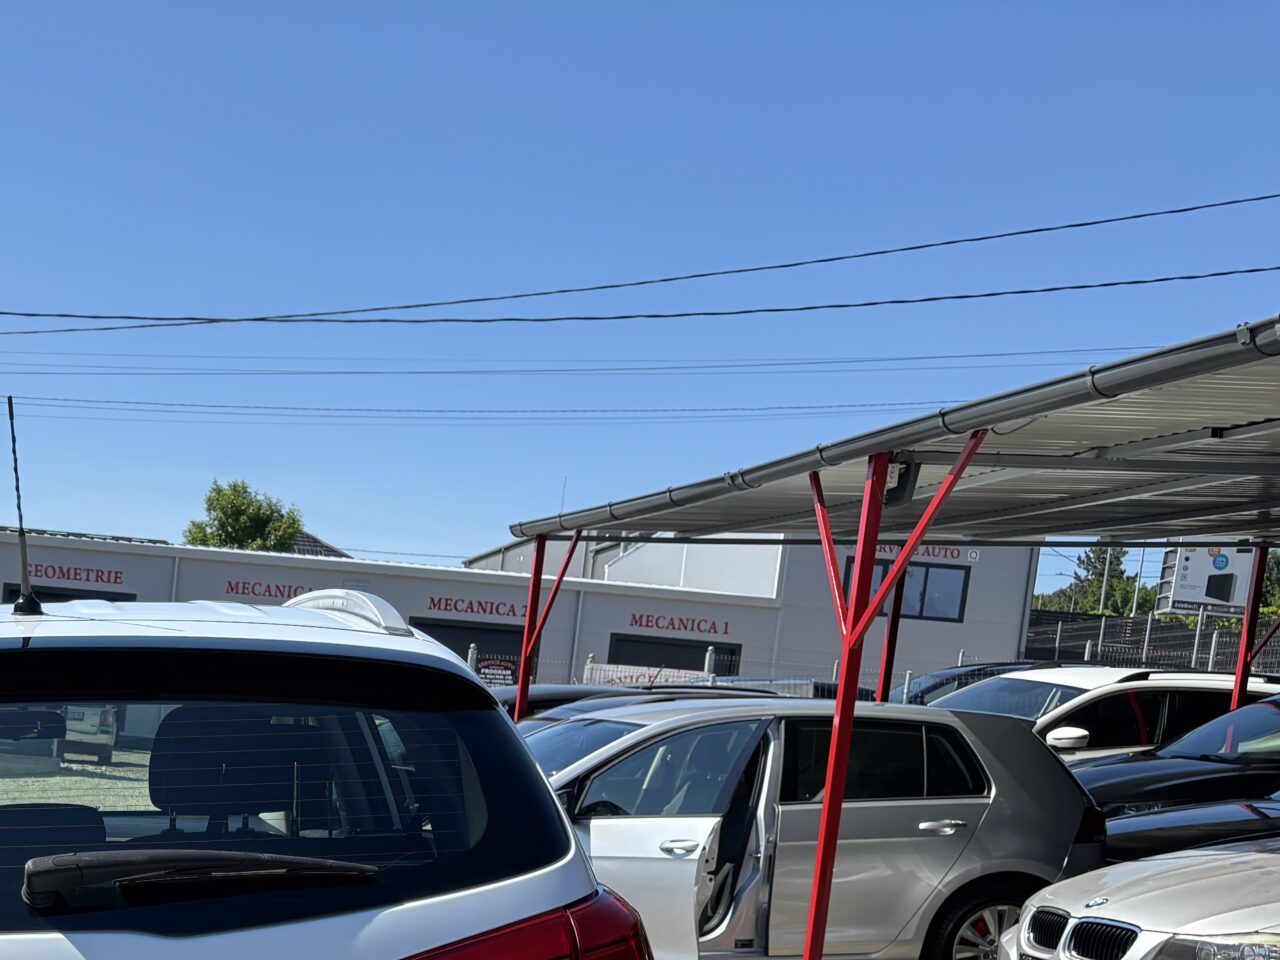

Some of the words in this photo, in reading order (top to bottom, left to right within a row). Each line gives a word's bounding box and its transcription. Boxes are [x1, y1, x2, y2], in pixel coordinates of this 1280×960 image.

[921, 546, 961, 560] AUTO
[226, 580, 313, 599] MECANIC
[428, 596, 517, 617] MECANICA
[629, 612, 718, 634] MECANICA
[722, 621, 729, 636] 1
